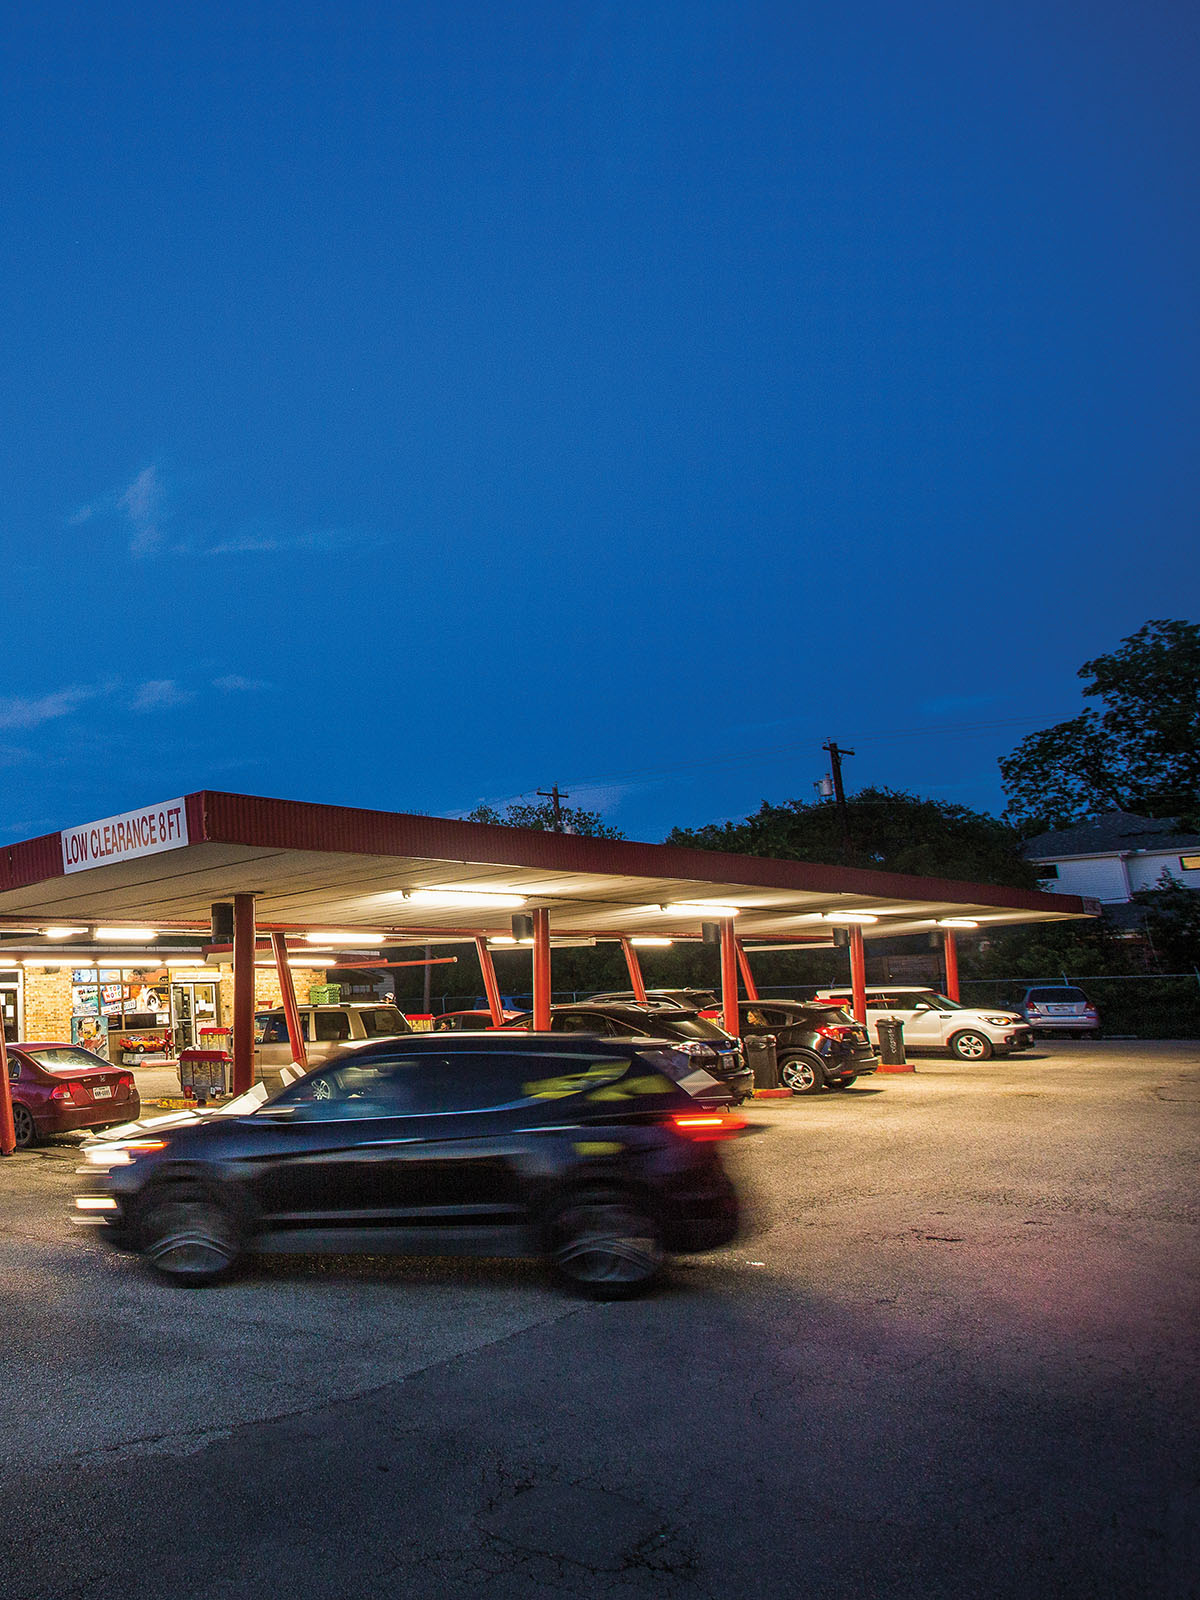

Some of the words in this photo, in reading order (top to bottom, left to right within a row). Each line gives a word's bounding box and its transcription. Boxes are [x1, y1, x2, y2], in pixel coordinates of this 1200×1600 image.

[64, 837, 88, 865] LOW
[90, 815, 157, 859] CLEARANCE
[159, 811, 167, 841] 8
[168, 807, 182, 839] FT
